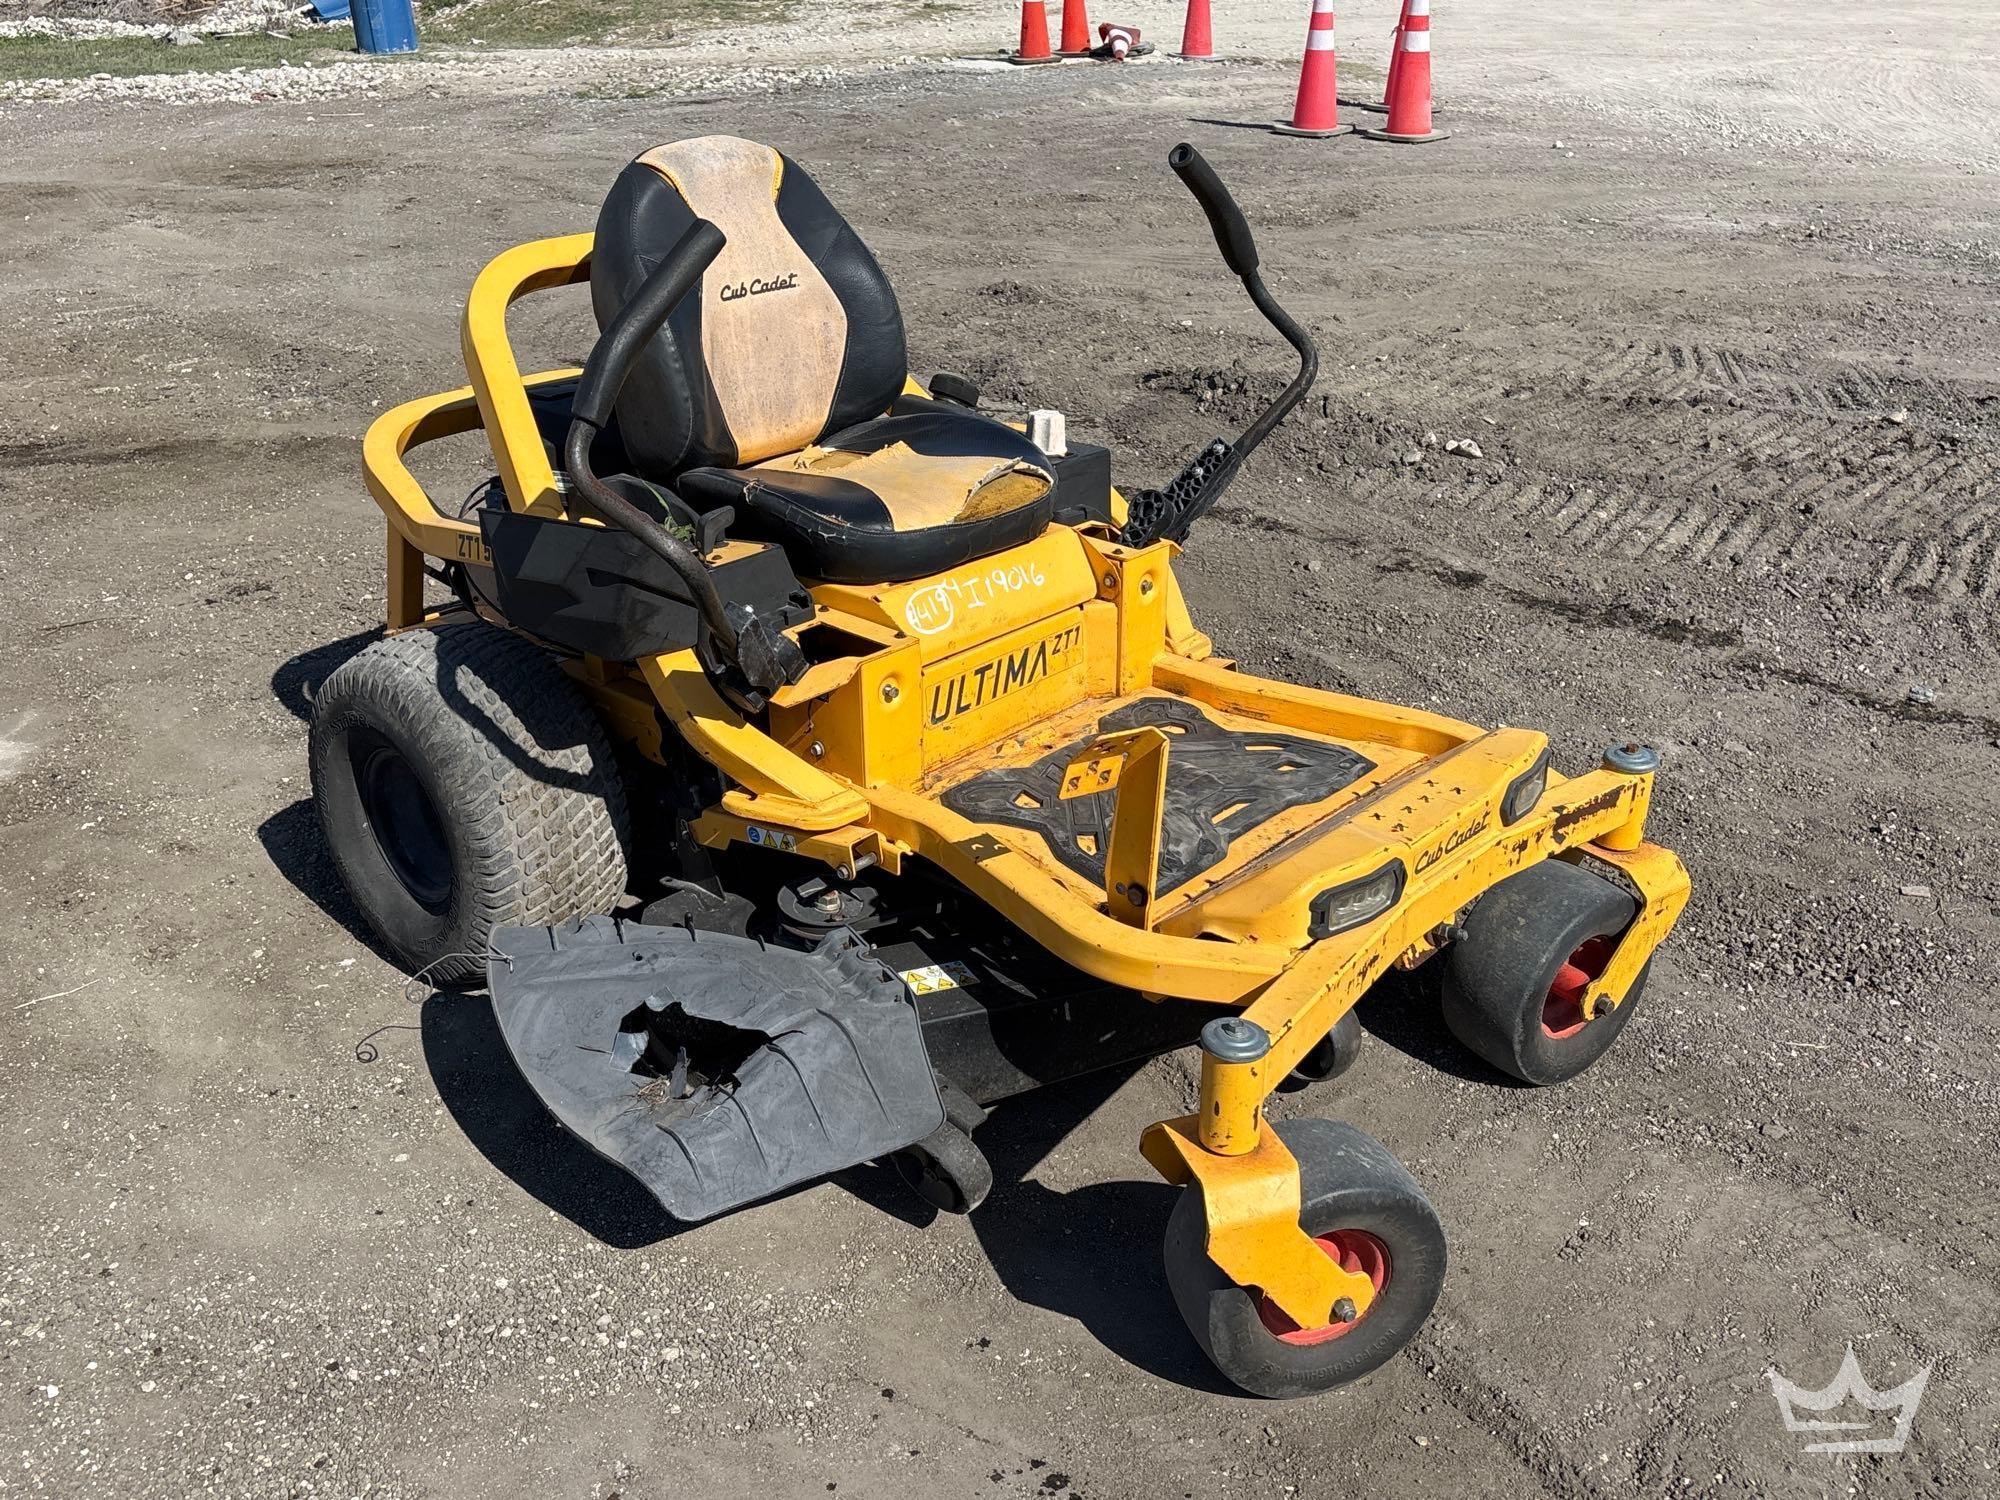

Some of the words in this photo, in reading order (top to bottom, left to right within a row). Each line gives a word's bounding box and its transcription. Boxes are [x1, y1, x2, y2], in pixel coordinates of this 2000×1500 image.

[720, 282, 747, 302] Cub
[750, 273, 798, 295] Cadet
[930, 640, 1047, 725] ULTIMA
[1051, 625, 1081, 656] ZT1
[1414, 841, 1443, 875] Cub
[1445, 810, 1491, 855] Cadet
